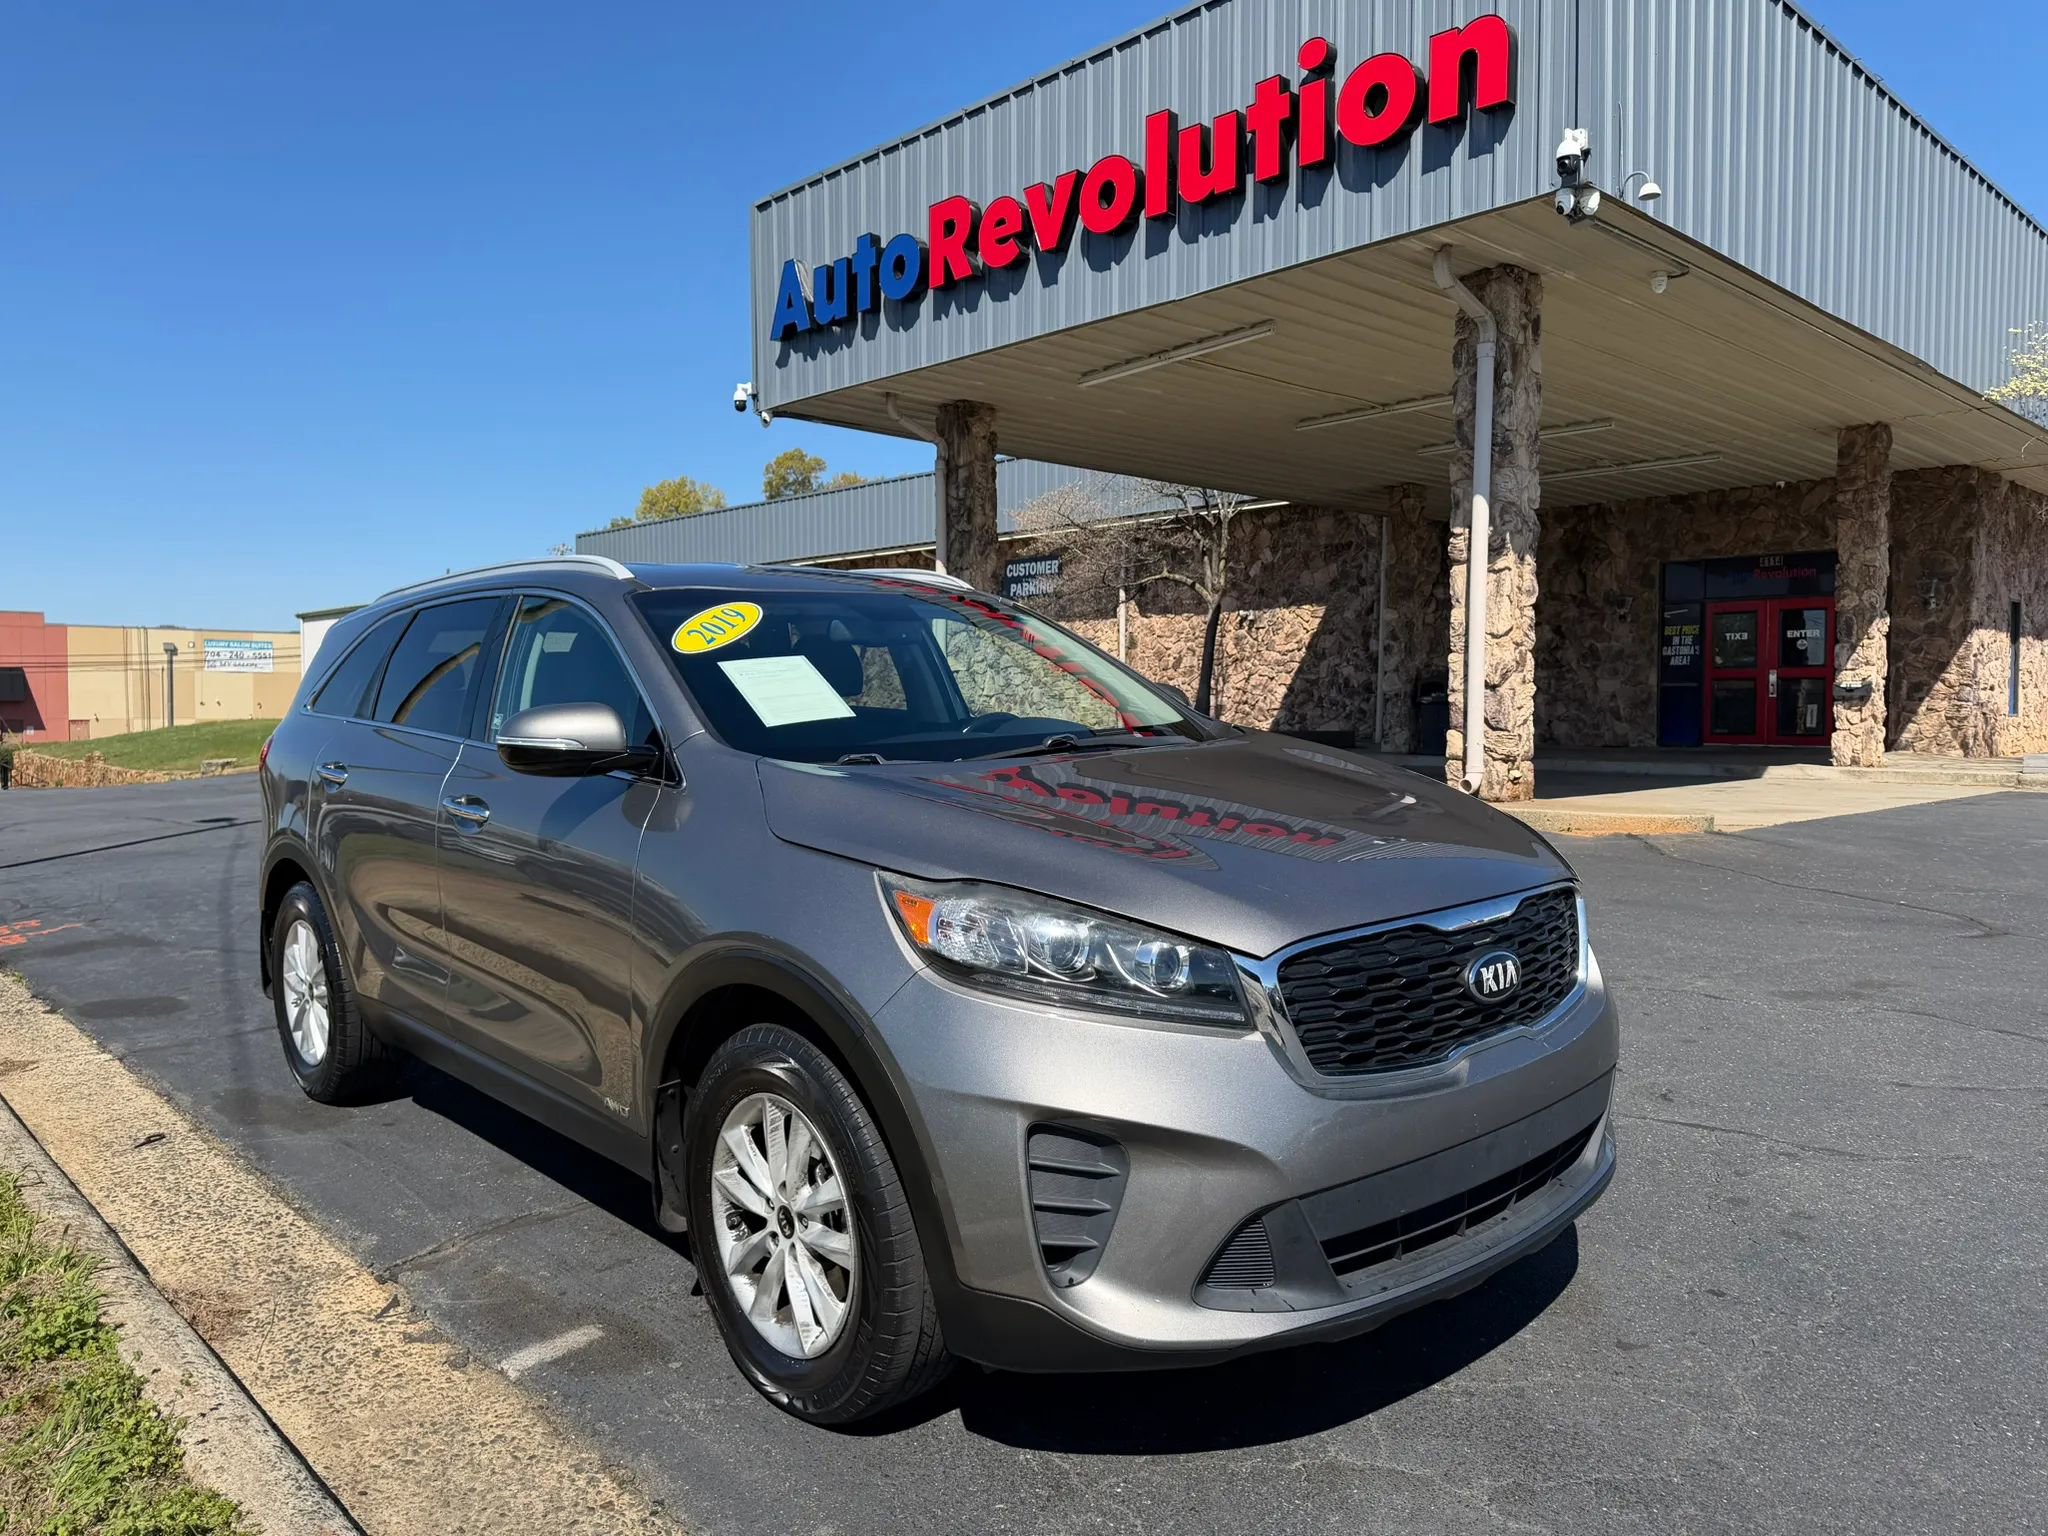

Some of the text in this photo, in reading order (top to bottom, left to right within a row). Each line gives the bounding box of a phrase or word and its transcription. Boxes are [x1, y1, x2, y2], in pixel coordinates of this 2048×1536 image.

[1006, 560, 1059, 578] CUSTOMER
[1010, 581, 1054, 597] PARKING
[687, 607, 746, 645] 2019
[1664, 625, 1681, 636] BEST
[1786, 629, 1820, 638] ENTER
[1672, 635, 1693, 645] IN THE
[1480, 960, 1518, 994] KIA
